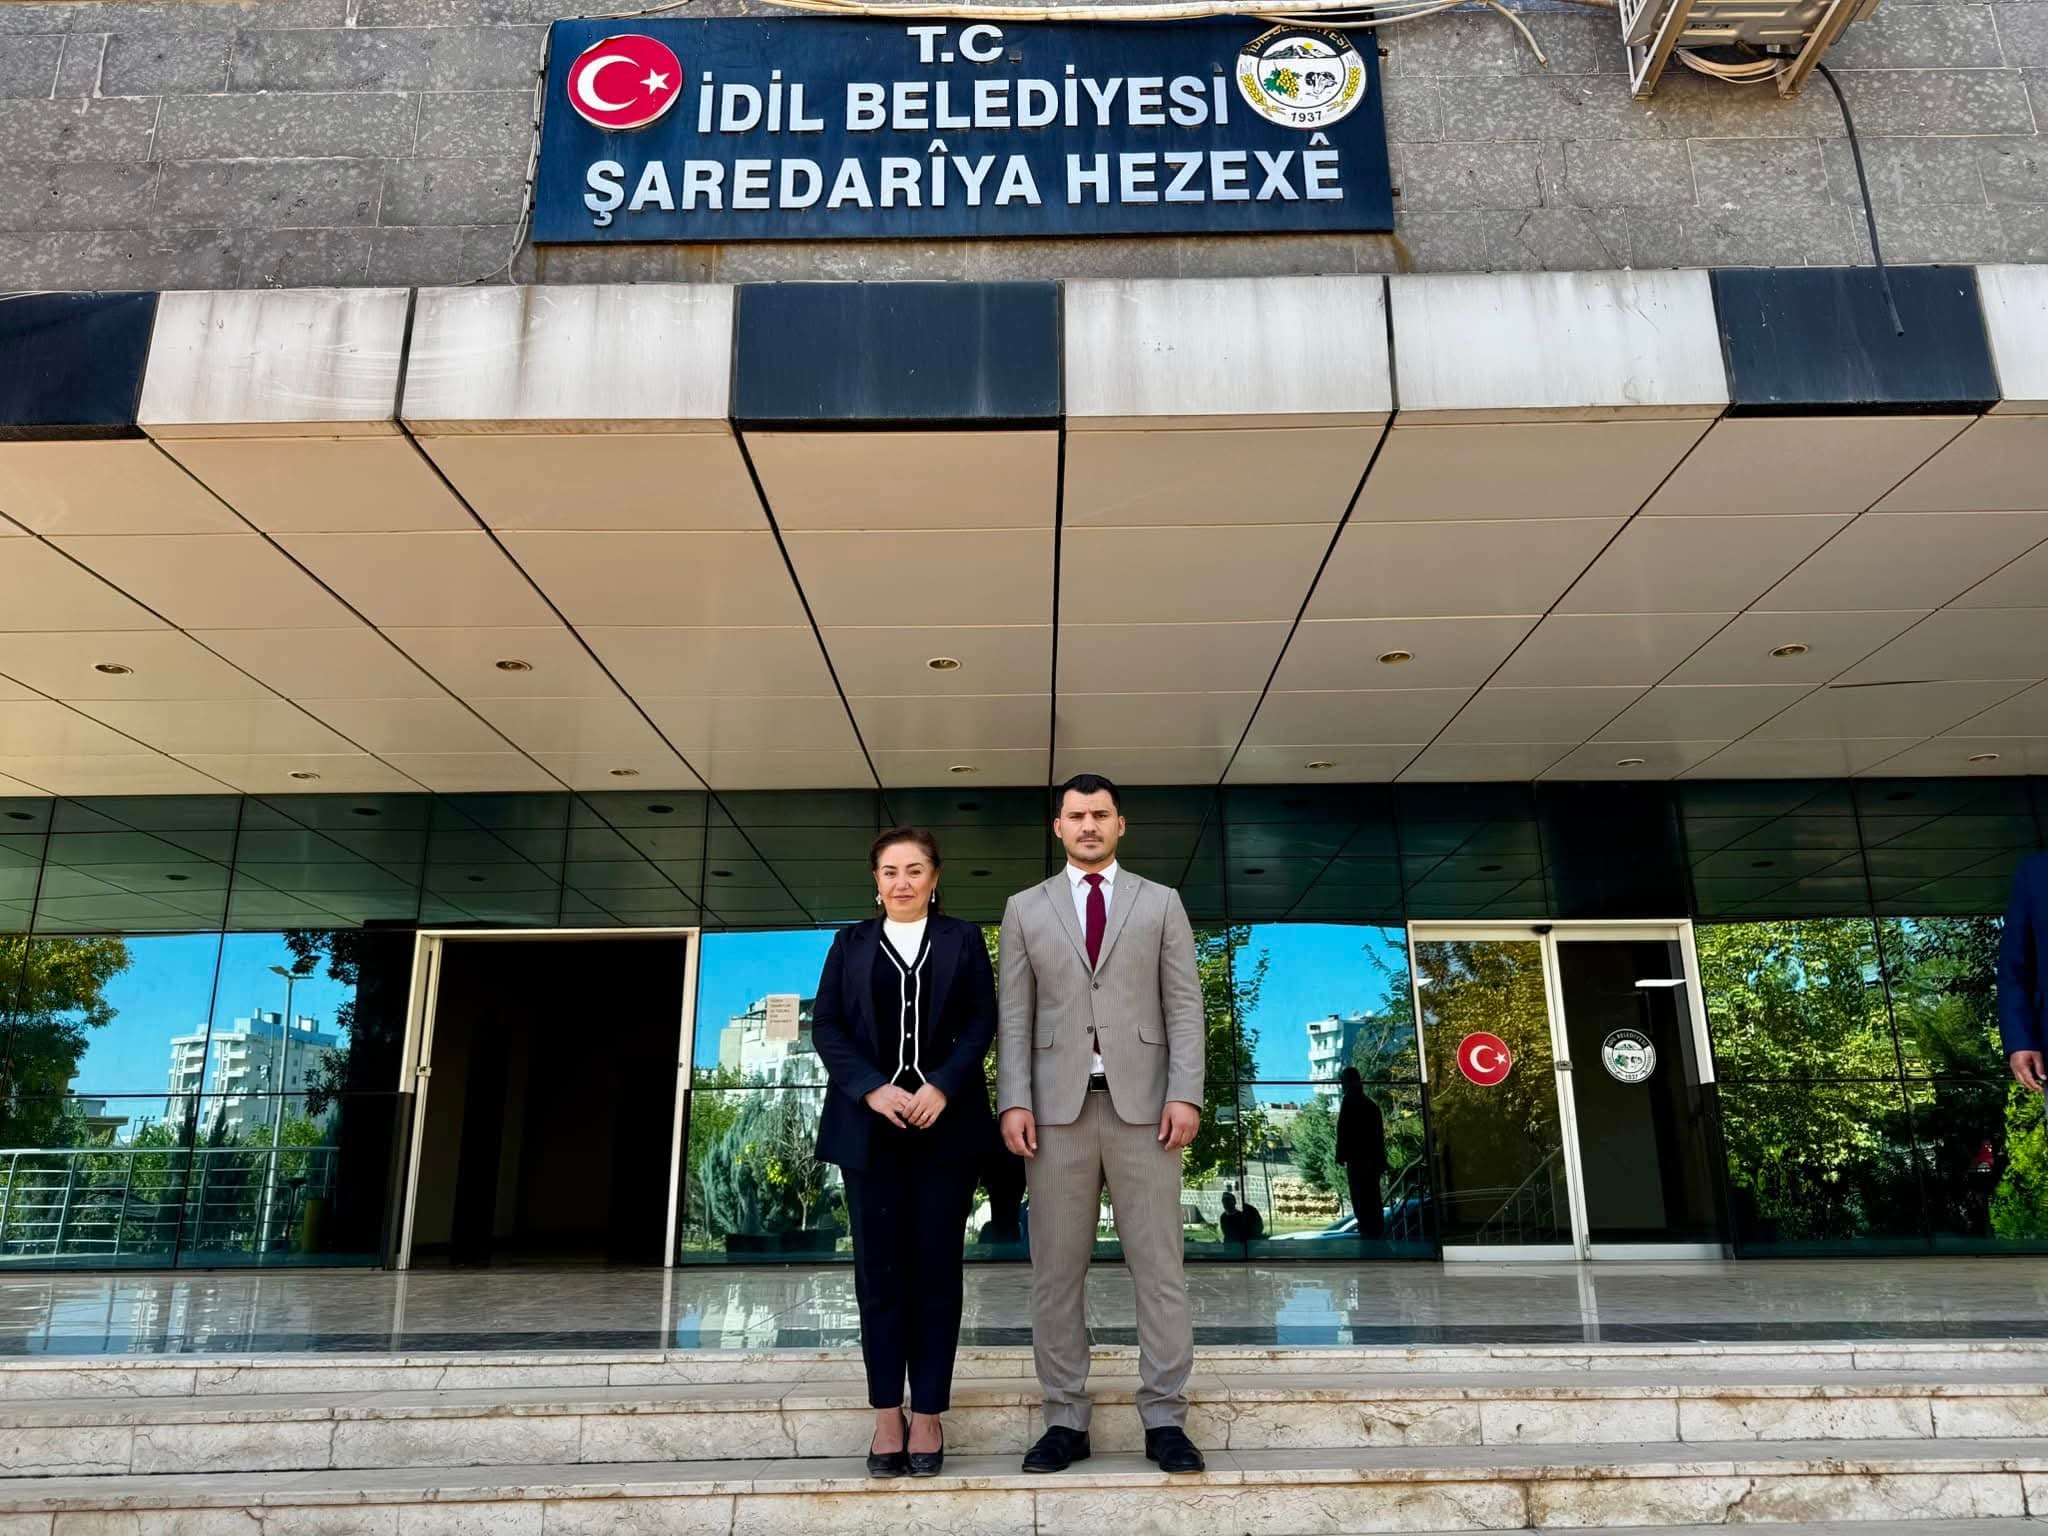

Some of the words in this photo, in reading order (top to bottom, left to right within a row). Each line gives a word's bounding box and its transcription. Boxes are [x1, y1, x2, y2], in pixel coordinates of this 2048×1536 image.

[697, 69, 824, 132] İDİL
[846, 63, 1229, 130] BELEDİYESİ
[1291, 111, 1323, 123] 1937
[583, 138, 1042, 227] ŞAREDARÎYA
[1066, 131, 1344, 204] HEZEXÊ
